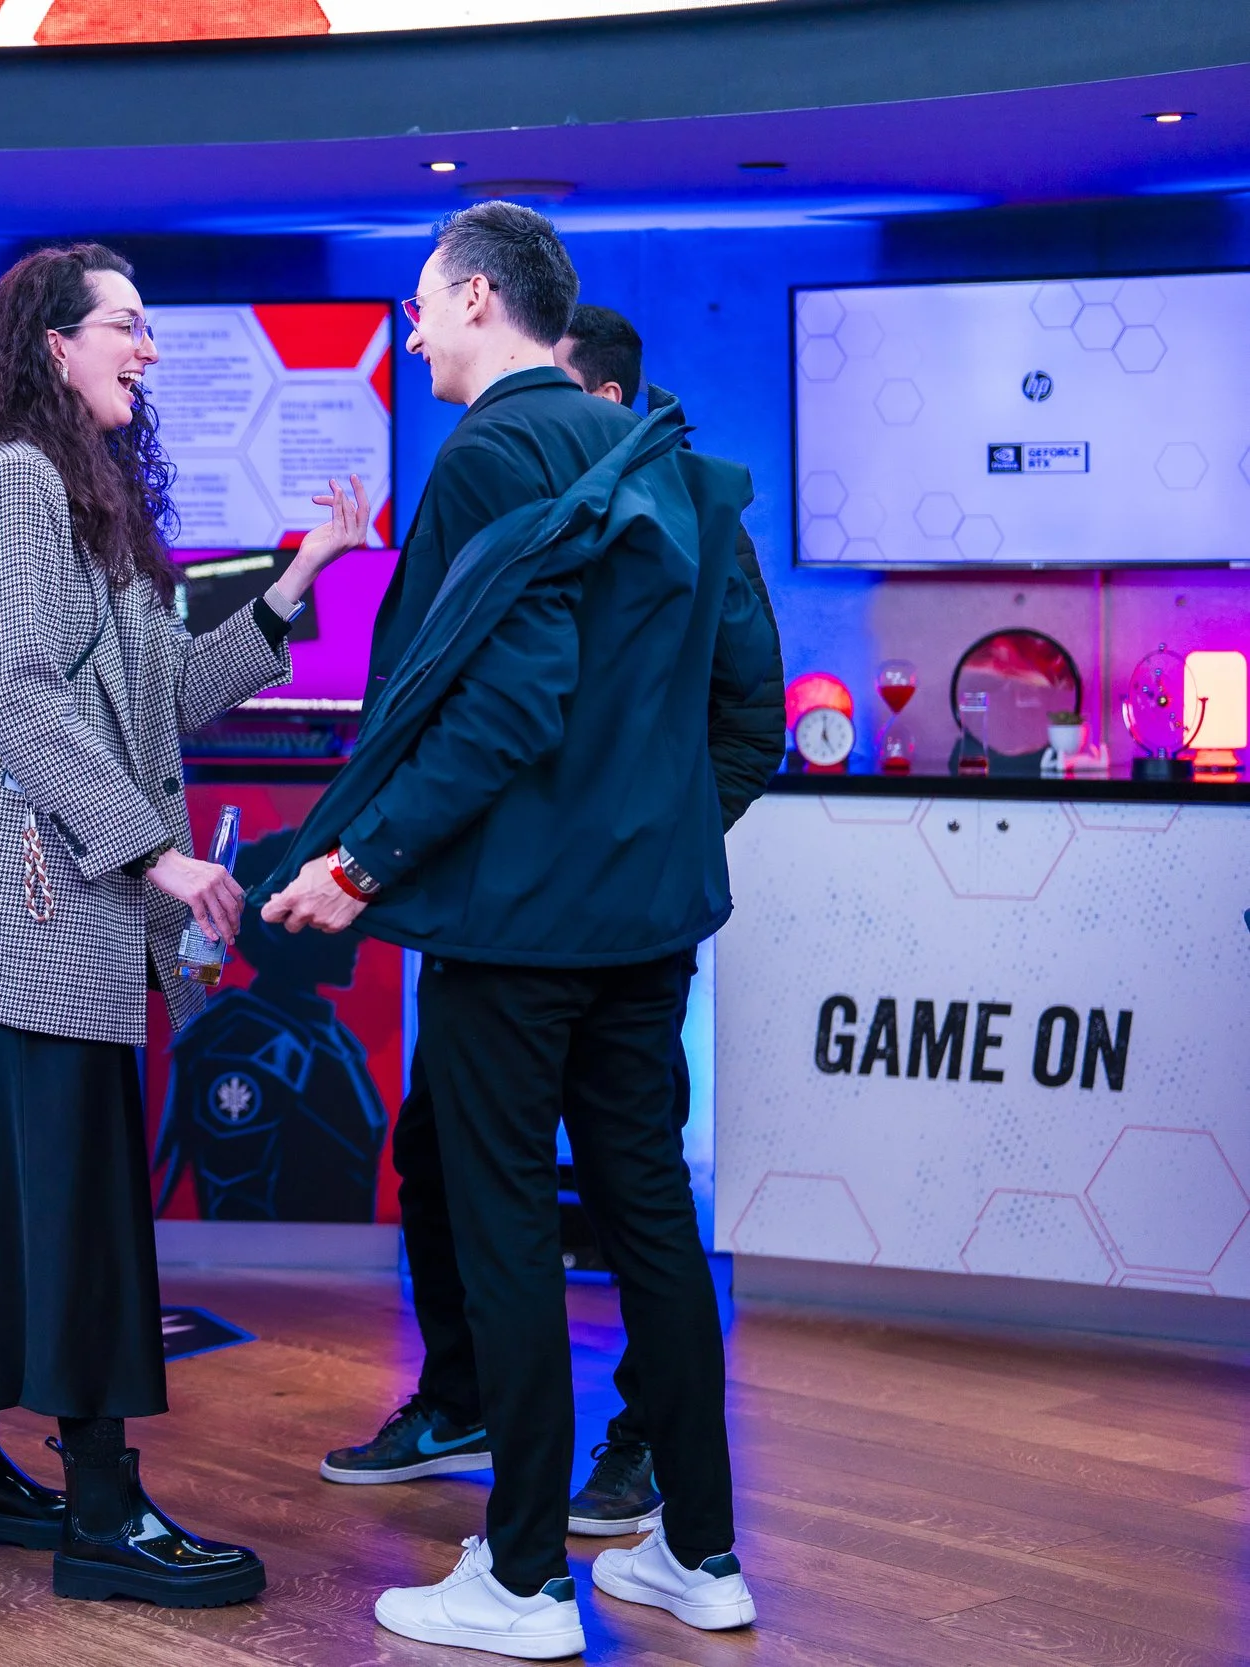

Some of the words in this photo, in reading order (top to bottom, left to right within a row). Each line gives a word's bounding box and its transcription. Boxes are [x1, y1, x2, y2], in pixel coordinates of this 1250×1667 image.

[1022, 370, 1053, 402] hp
[814, 994, 1012, 1083] GAME
[1032, 1004, 1133, 1092] ON
